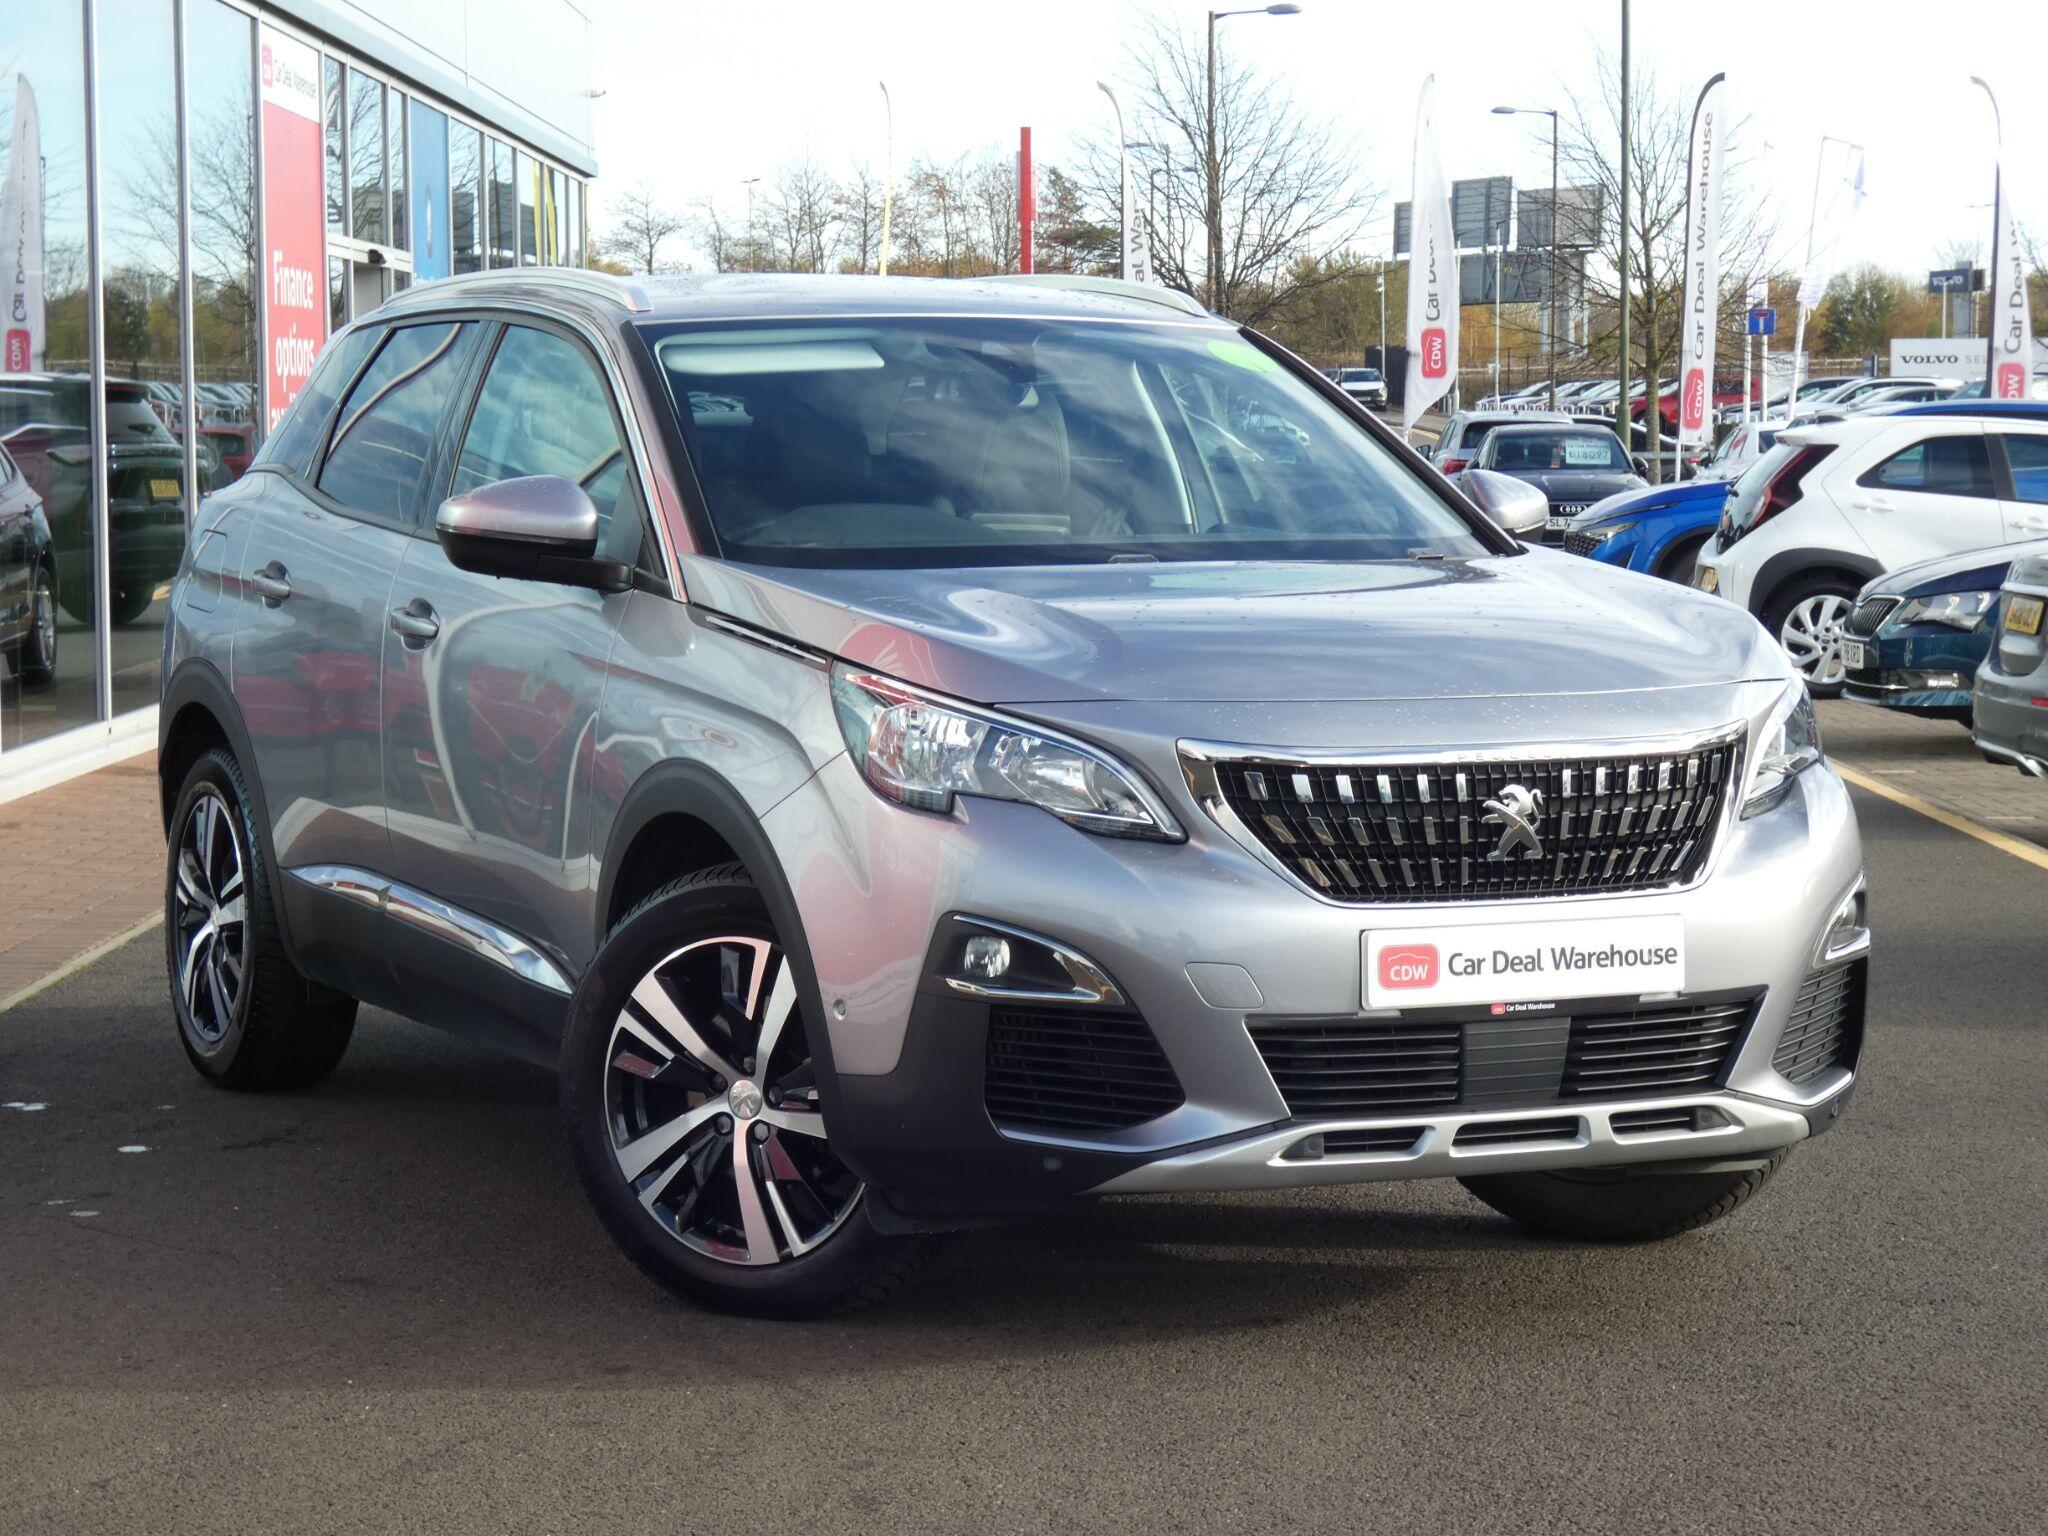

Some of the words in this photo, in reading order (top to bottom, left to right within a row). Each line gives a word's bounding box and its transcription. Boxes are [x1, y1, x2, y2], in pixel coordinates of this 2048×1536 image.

[1697, 111, 1713, 252] Warehouse
[273, 249, 314, 310] Finance
[1931, 275, 1964, 286] VOVO
[2009, 255, 2024, 309] Deal
[1426, 293, 1441, 322] Car
[1430, 336, 1442, 369] CDW
[1694, 320, 1705, 360] Car
[2004, 315, 2023, 354] Car
[275, 322, 316, 392] options
[1901, 355, 1959, 364] VOLVO
[1694, 380, 1704, 418] CDW
[2007, 372, 2021, 398] DW
[1389, 964, 1429, 982] CDW
[1448, 952, 1486, 976] Car
[1492, 948, 1544, 974] Deal
[1550, 944, 1678, 970] Warehouse
[1506, 1004, 1515, 1012] Car
[1515, 1003, 1527, 1011] Deal
[1527, 1002, 1556, 1010] Warehouse
